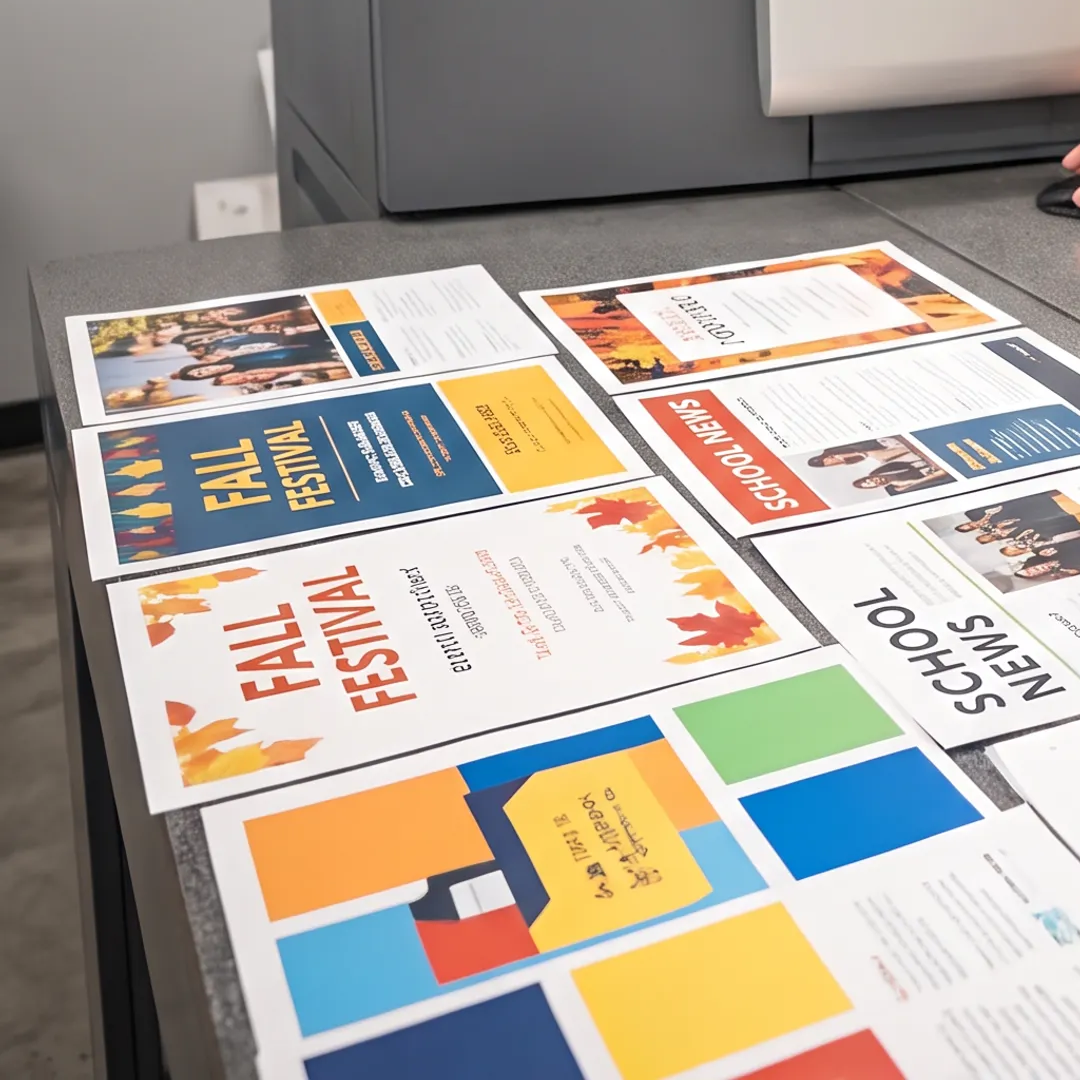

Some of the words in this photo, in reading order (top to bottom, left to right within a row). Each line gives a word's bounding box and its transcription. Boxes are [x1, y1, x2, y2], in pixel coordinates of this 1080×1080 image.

[264, 420, 335, 512] FESTIVAL
[667, 398, 734, 447] NEWS
[191, 438, 271, 511] FALL
[713, 443, 799, 511] SCHOOL
[223, 603, 321, 702] FALL
[303, 565, 417, 712] FESTIVAL
[853, 587, 1005, 714] SCHOOL
[947, 614, 1066, 701] NEWS
